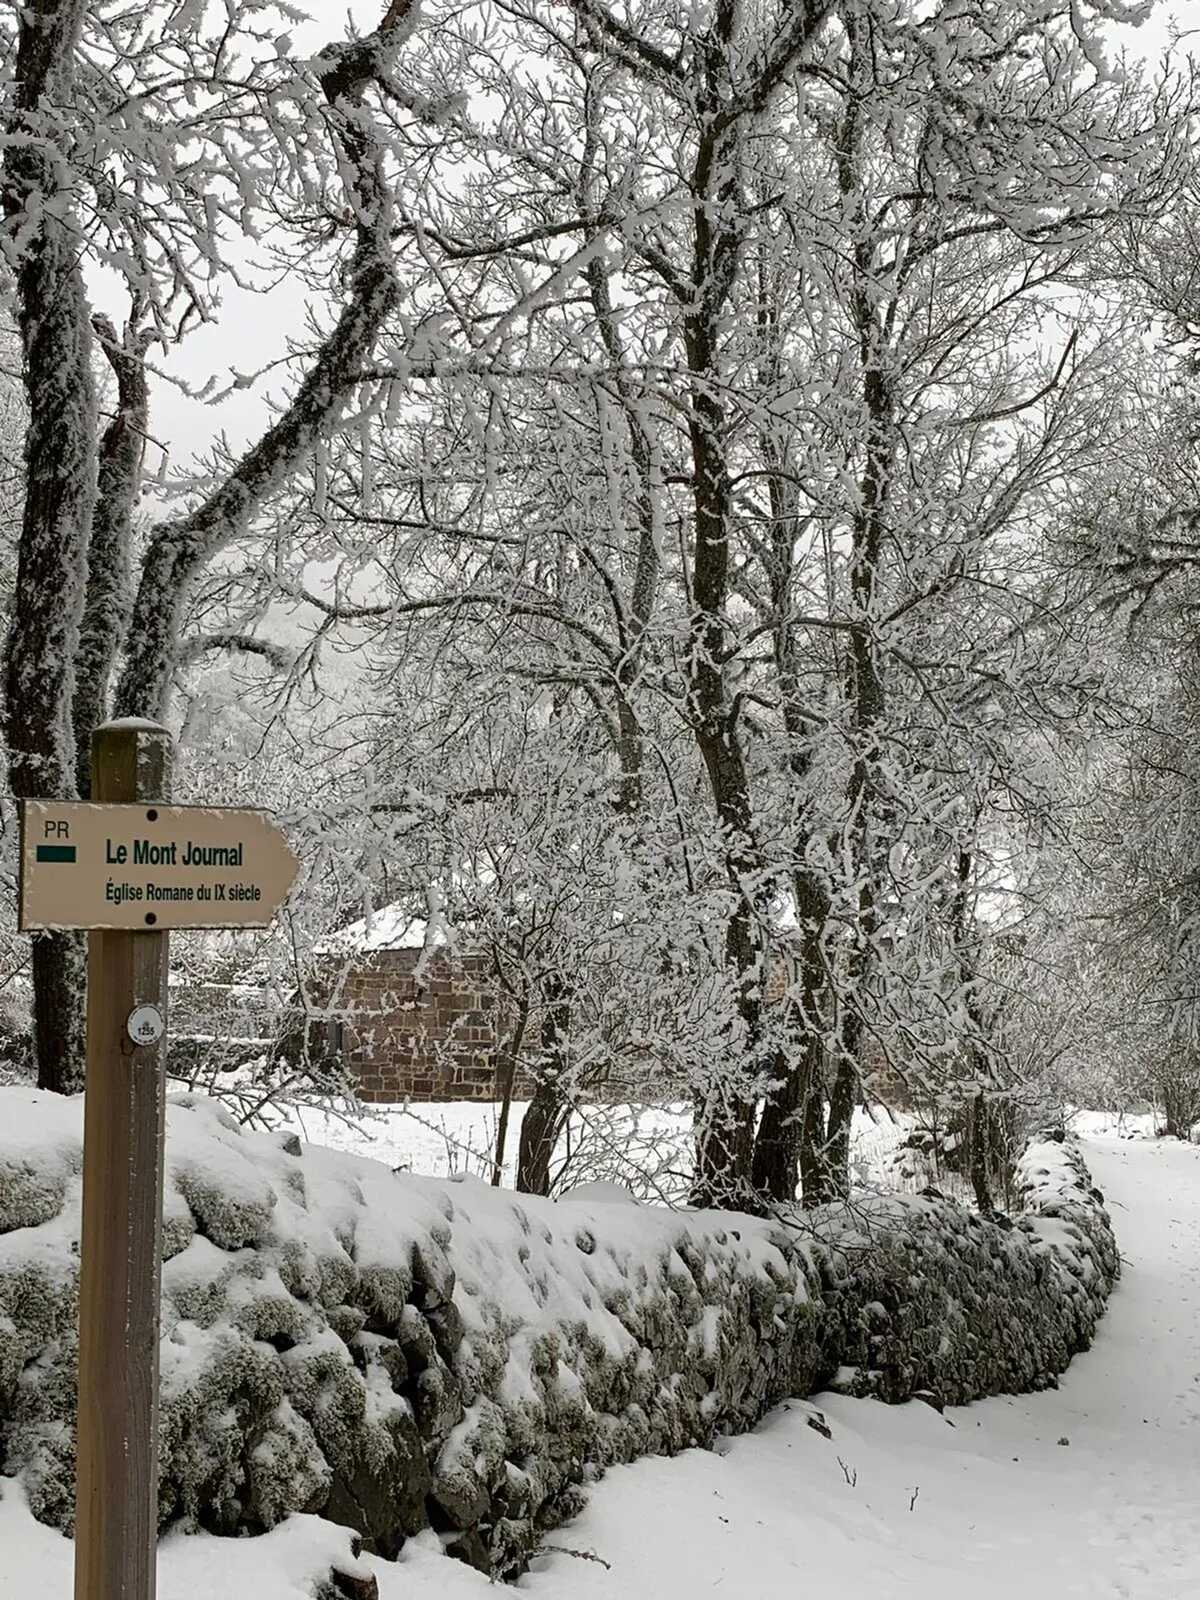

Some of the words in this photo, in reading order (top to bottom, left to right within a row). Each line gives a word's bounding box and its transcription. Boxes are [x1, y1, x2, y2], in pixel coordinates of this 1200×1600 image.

[44, 820, 69, 839] PR
[106, 839, 127, 864] Le
[133, 840, 177, 865] Mont
[181, 842, 243, 866] Journal
[105, 877, 142, 904] Église
[146, 884, 194, 901] Romane
[197, 884, 212, 901] du
[215, 884, 226, 901] IX
[229, 883, 261, 901] siècle
